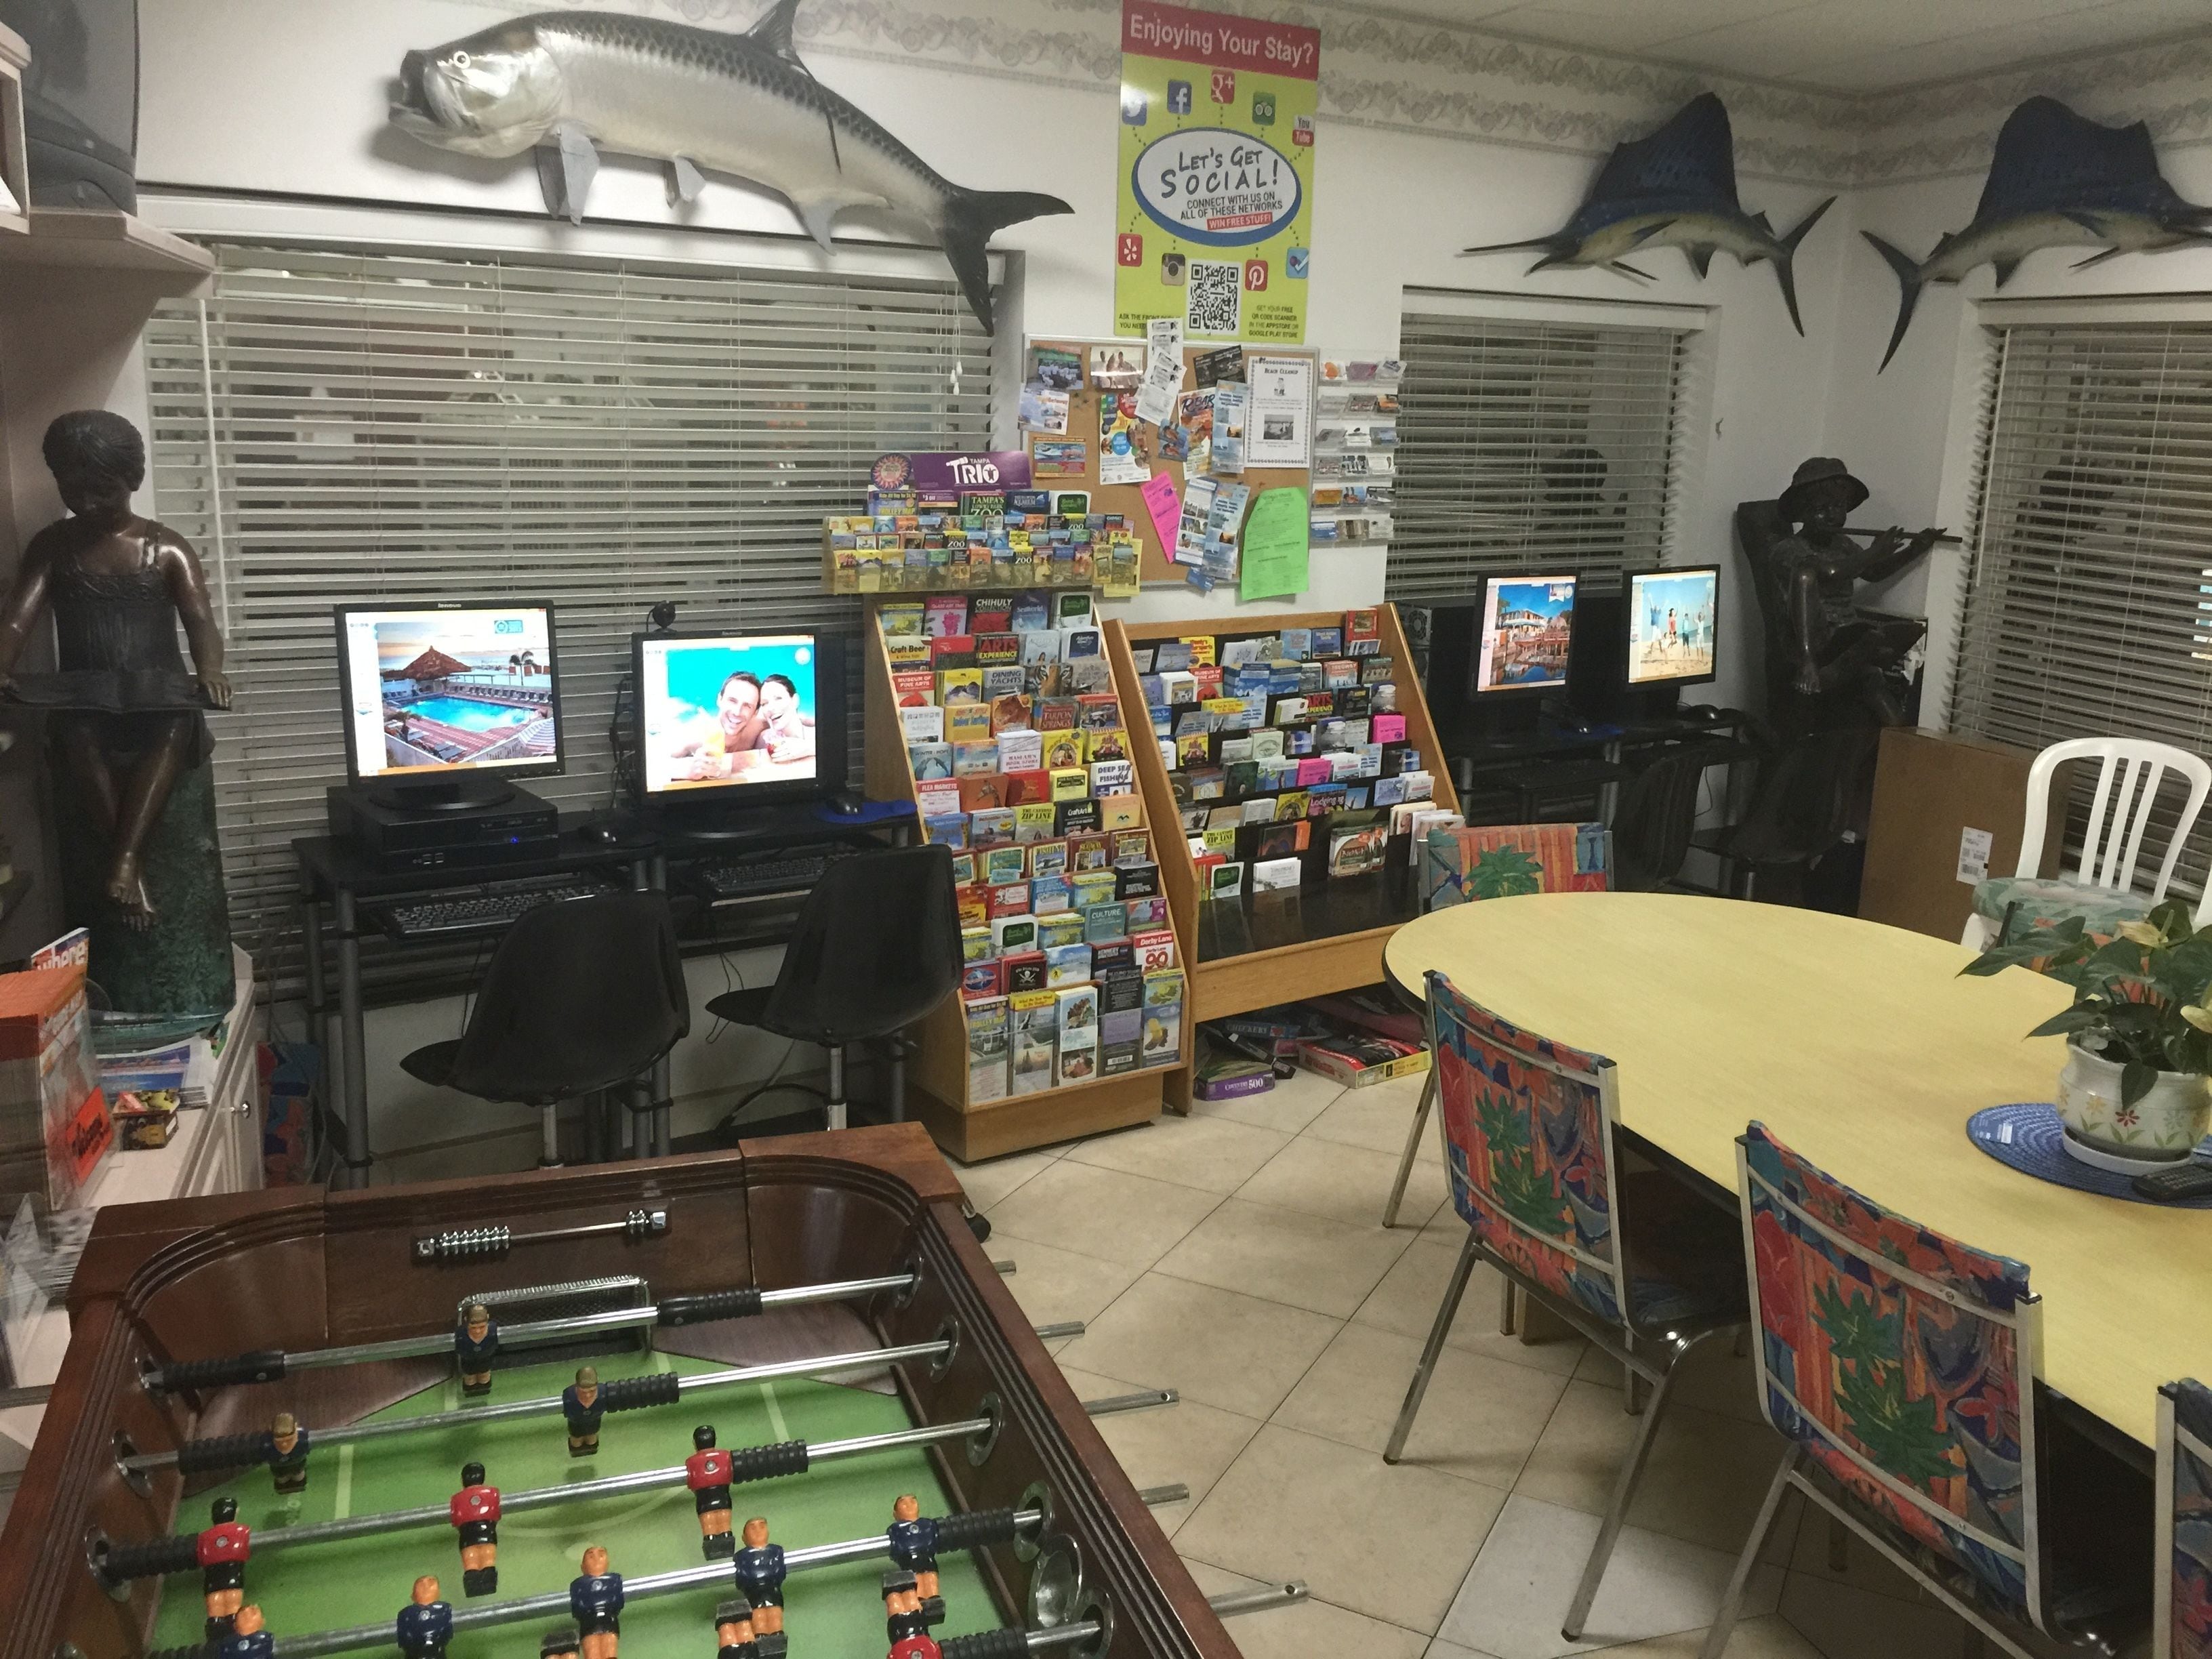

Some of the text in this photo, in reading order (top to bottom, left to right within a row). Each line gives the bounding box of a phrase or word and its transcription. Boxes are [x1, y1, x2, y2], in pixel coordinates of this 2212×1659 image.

[1130, 14, 1314, 68] Enjoying Your Stay?
[1297, 117, 1310, 129] You
[1295, 131, 1311, 144] Tube
[1231, 146, 1263, 167] GET
[1160, 159, 1279, 199] SOCIAL!
[1187, 192, 1275, 209] CONNECT WITH US ON
[1181, 201, 1283, 220] ALL OF THESE NETWORKS
[1208, 213, 1272, 230] WIN FREE STUFF!
[945, 456, 1000, 485] TRIO
[982, 638, 1017, 651] ARTS
[1307, 694, 1332, 705] ARTS
[1044, 712, 1072, 720] TARPON
[1042, 720, 1071, 729] SPRINGS
[1099, 774, 1129, 783] FISHING
[1310, 796, 1336, 807] Lodging
[1091, 908, 1122, 920] CULTURE
[1140, 938, 1158, 946] Derby
[1248, 1078, 1264, 1090] 500
